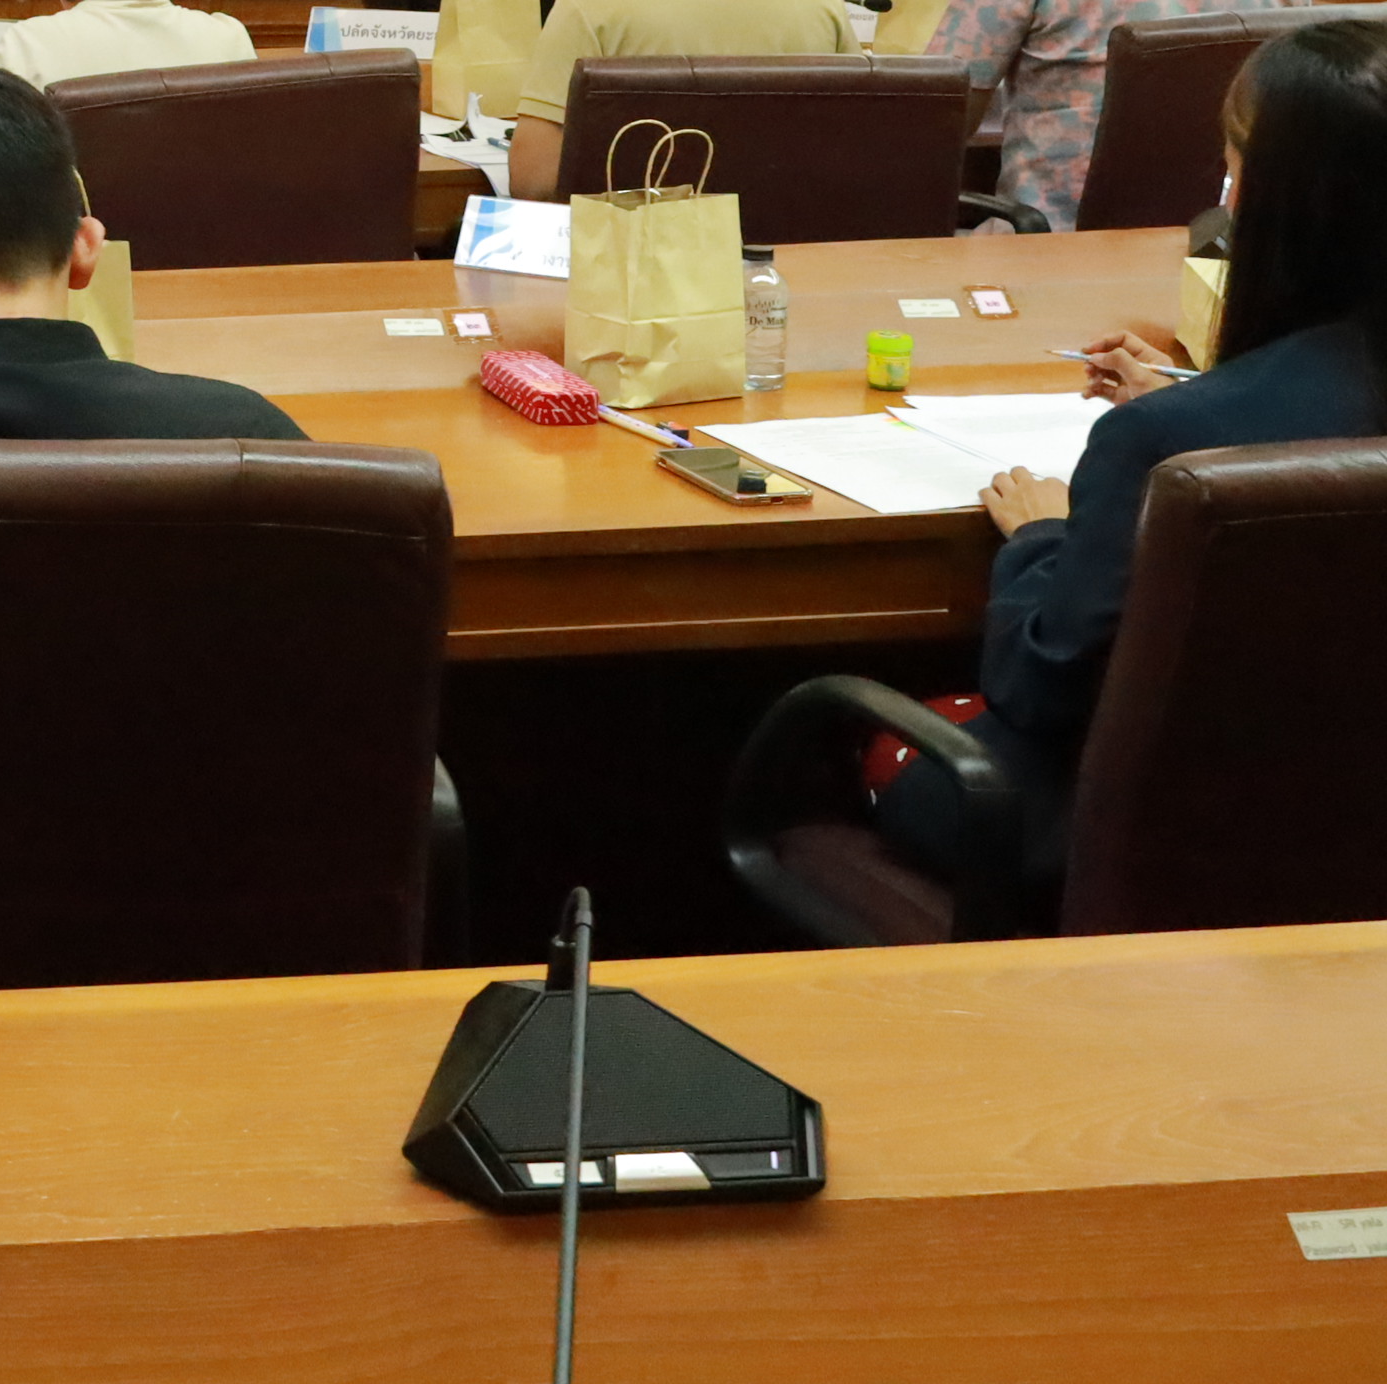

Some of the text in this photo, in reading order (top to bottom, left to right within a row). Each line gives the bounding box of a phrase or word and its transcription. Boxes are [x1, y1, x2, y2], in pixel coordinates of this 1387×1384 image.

[340, 23, 439, 41] ปลัดจังหวัดยะ
